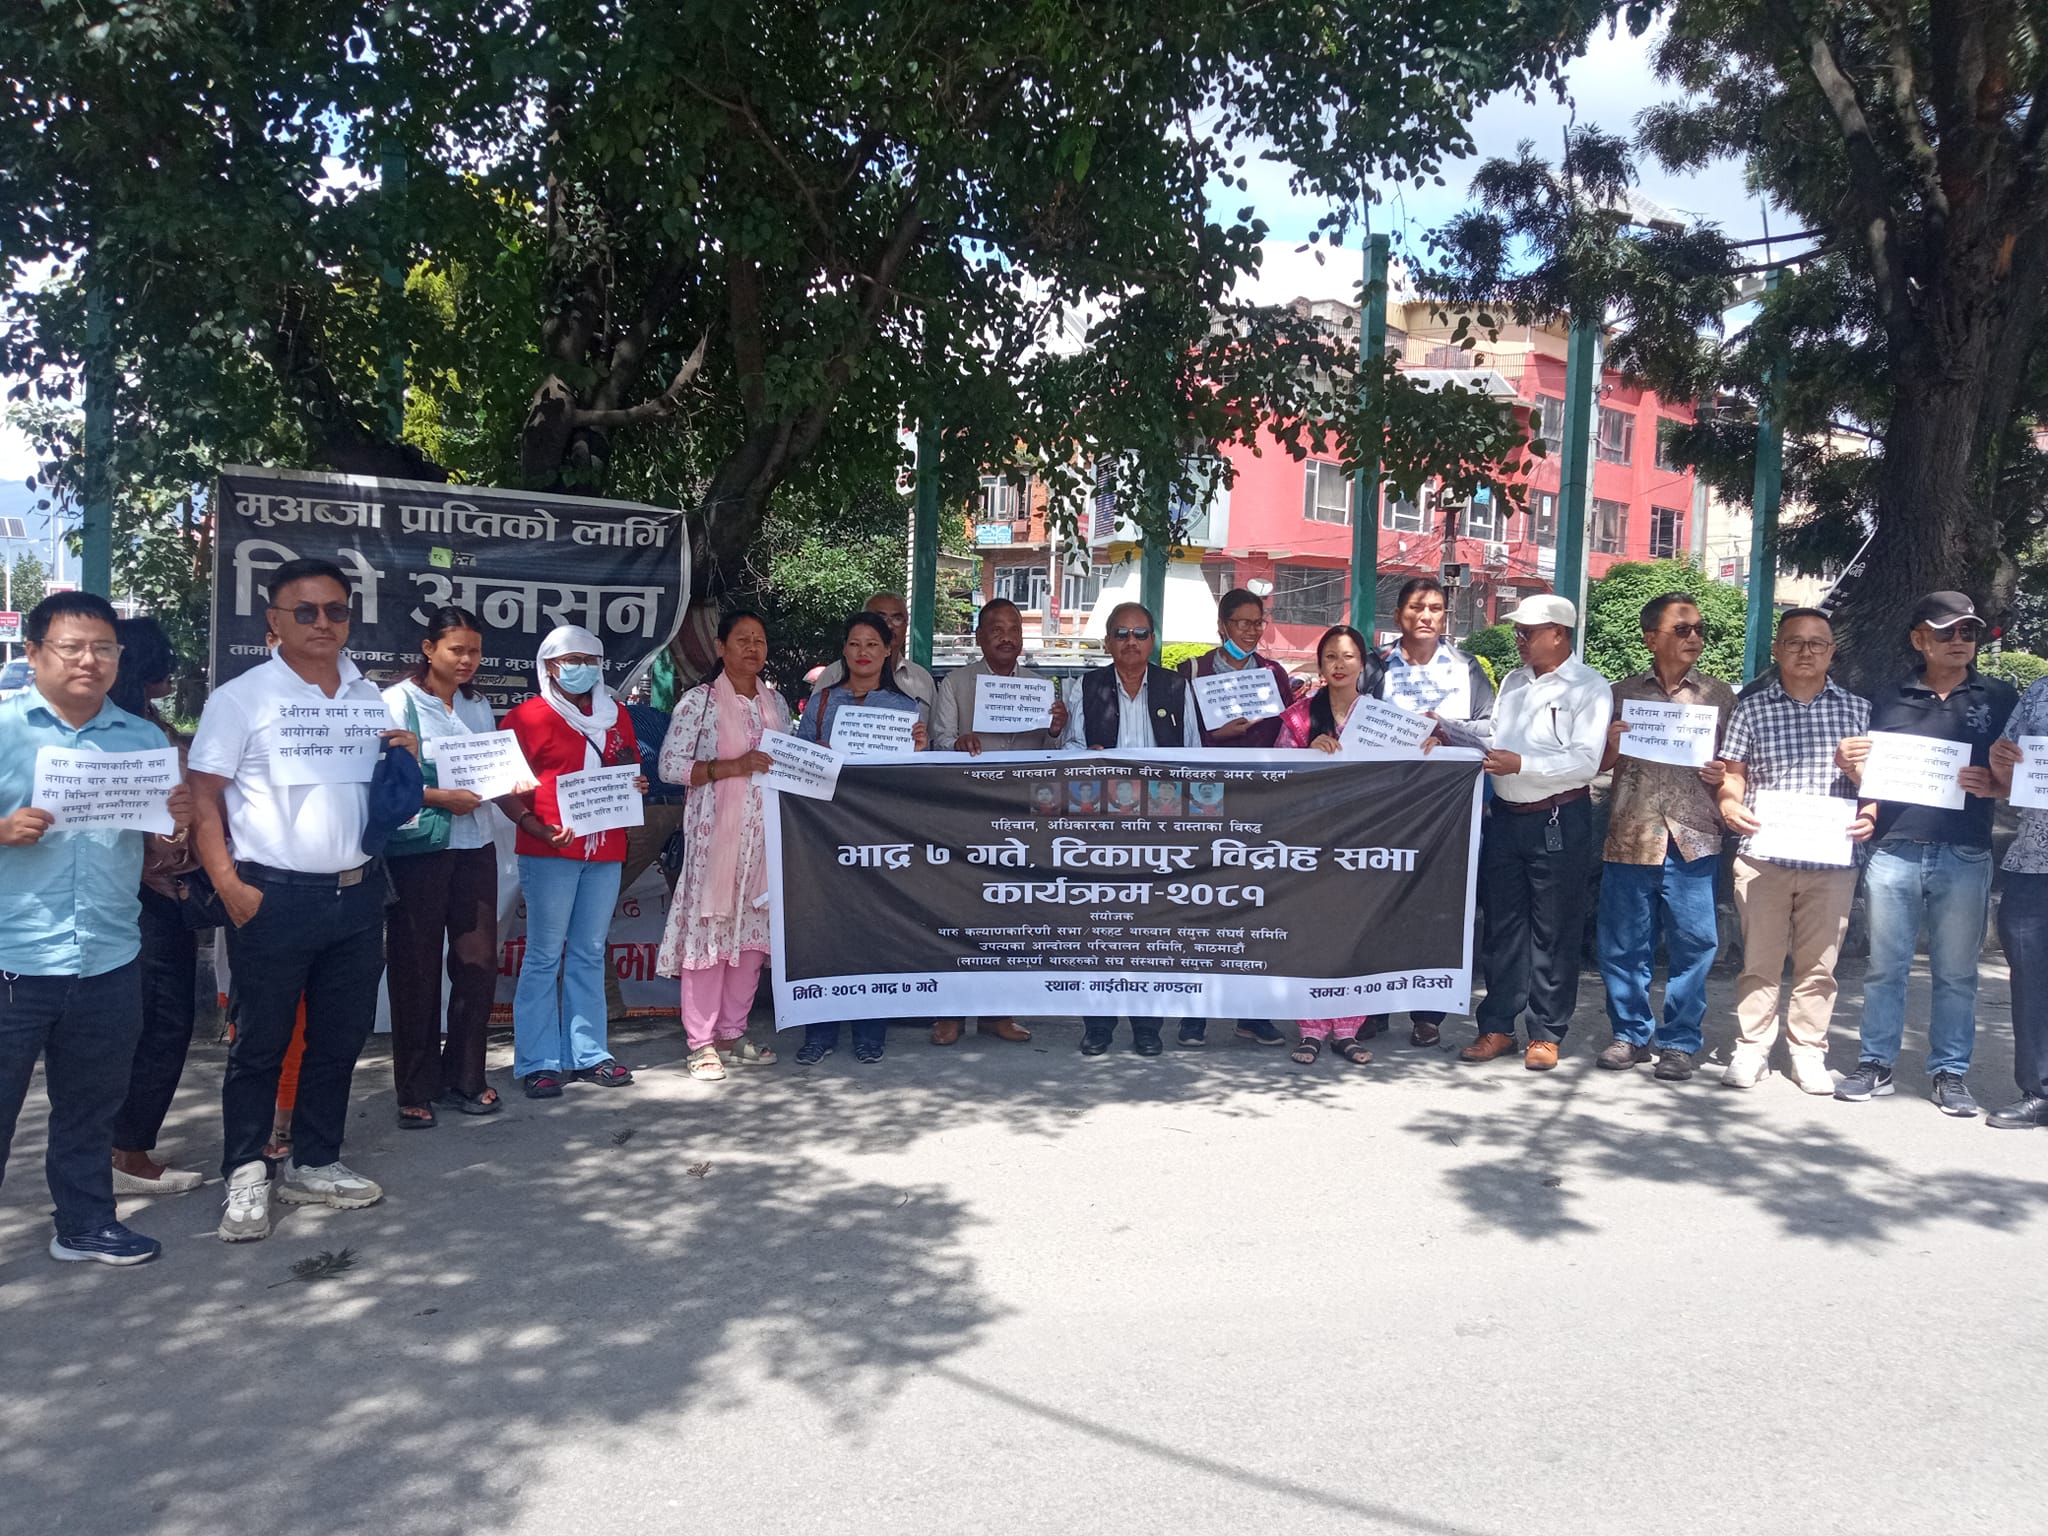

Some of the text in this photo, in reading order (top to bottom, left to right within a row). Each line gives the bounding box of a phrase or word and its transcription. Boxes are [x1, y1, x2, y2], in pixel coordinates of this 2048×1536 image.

[234, 492, 668, 547] मुअब्जा प्राप्तिको लागि
[325, 705, 348, 718] शर्मा
[352, 708, 360, 718] र
[363, 708, 385, 718] लाल
[280, 724, 330, 737] आयोगको
[339, 745, 355, 755] गर
[1673, 739, 1686, 748] गर
[74, 759, 143, 771] कल्याणकारिणी
[147, 758, 167, 769] सभा
[1064, 764, 1132, 777] आन्दोलनका
[1224, 769, 1255, 780] अमर
[45, 773, 82, 785] लगायत
[104, 789, 140, 797] समयमा
[120, 812, 135, 820] गर
[991, 817, 1039, 832] पहिचान,
[1048, 817, 1115, 832] अधिकारका
[1121, 818, 1151, 831] लागि
[1157, 821, 1168, 832] र
[838, 836, 1419, 874] भाद्र ७ गते, टिकापुर विद्रोह सभा
[982, 877, 1265, 907] कार्यक्रम-२०८१
[1090, 911, 1134, 921] संयोजक
[965, 923, 1051, 937] कल्याणकारिणी
[1250, 927, 1288, 940] समिति
[979, 941, 1026, 951] उपत्यका
[1032, 939, 1081, 951] आन्दोलन
[1087, 938, 1140, 952] परिचालन
[1146, 939, 1186, 954] समिति,
[831, 984, 866, 996] २०८१
[871, 982, 898, 995] भाद्र
[902, 982, 911, 993] ७
[916, 978, 939, 993] गते
[1089, 978, 1150, 993] माईतीघर
[1153, 981, 1203, 993] मण्डला
[1386, 977, 1408, 991] बजे
[1412, 974, 1454, 989] दिउसो
